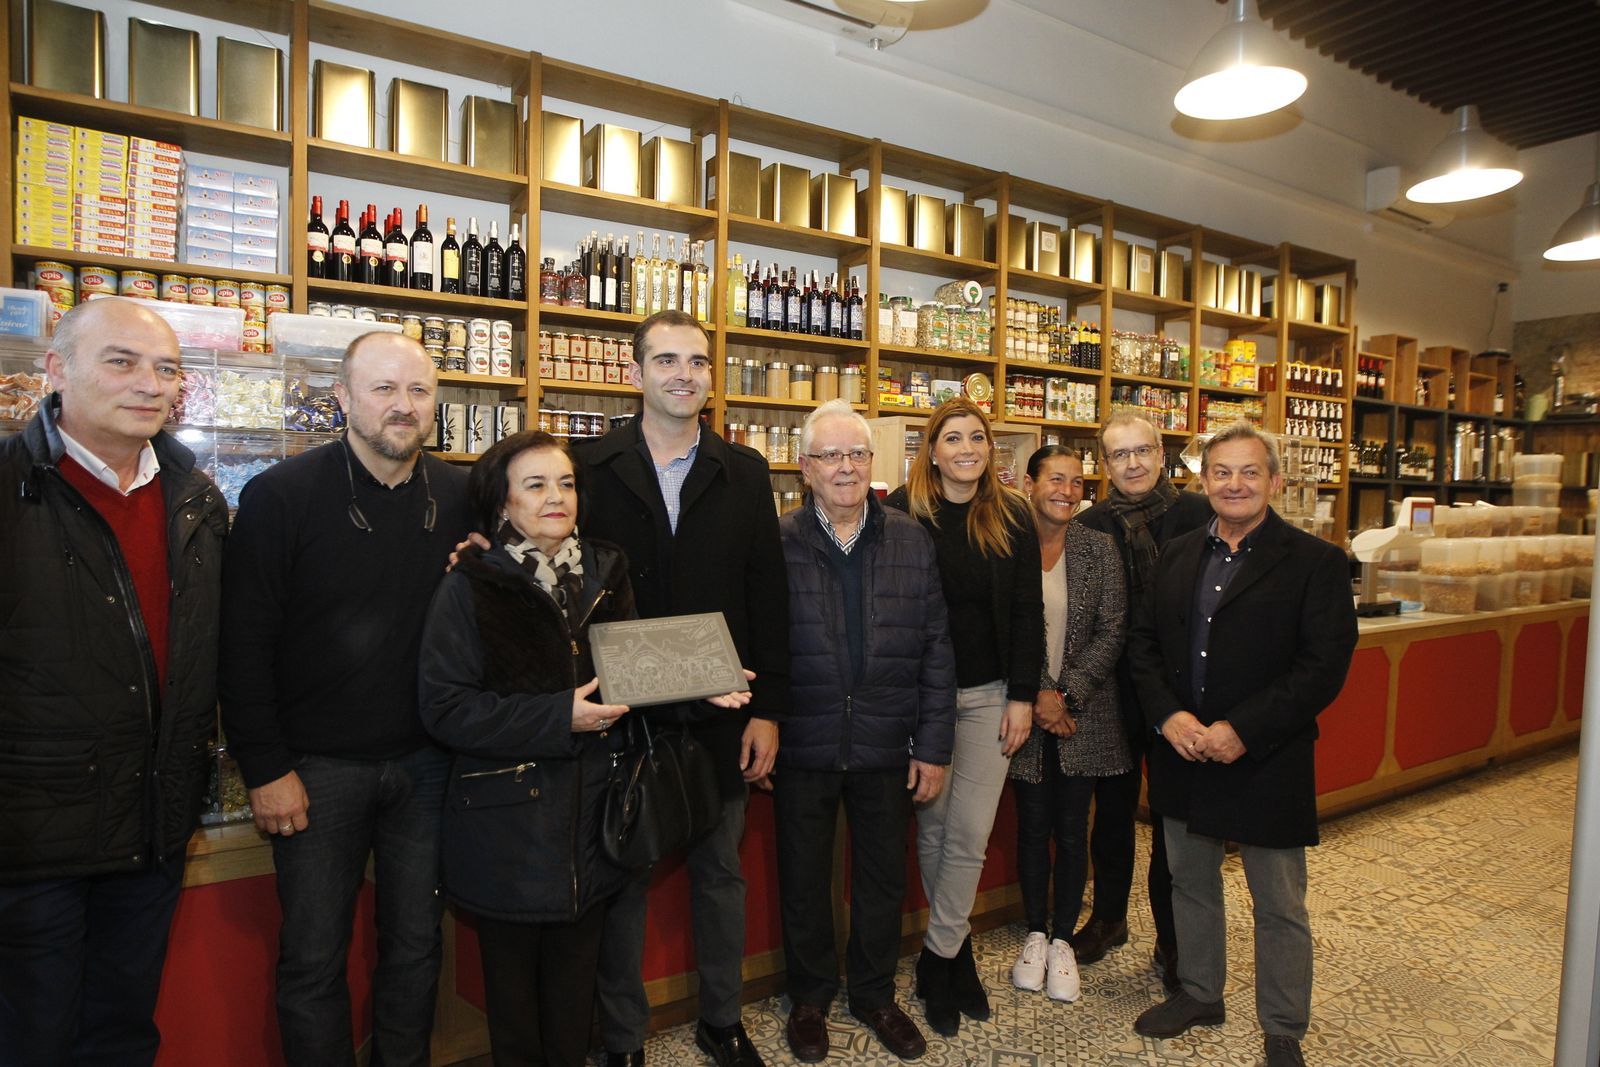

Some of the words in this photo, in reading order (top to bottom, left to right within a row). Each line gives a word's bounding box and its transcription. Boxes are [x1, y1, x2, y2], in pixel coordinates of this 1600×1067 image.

[42, 272, 60, 280] apis
[136, 281, 152, 289] apis
[193, 287, 207, 296] apis
